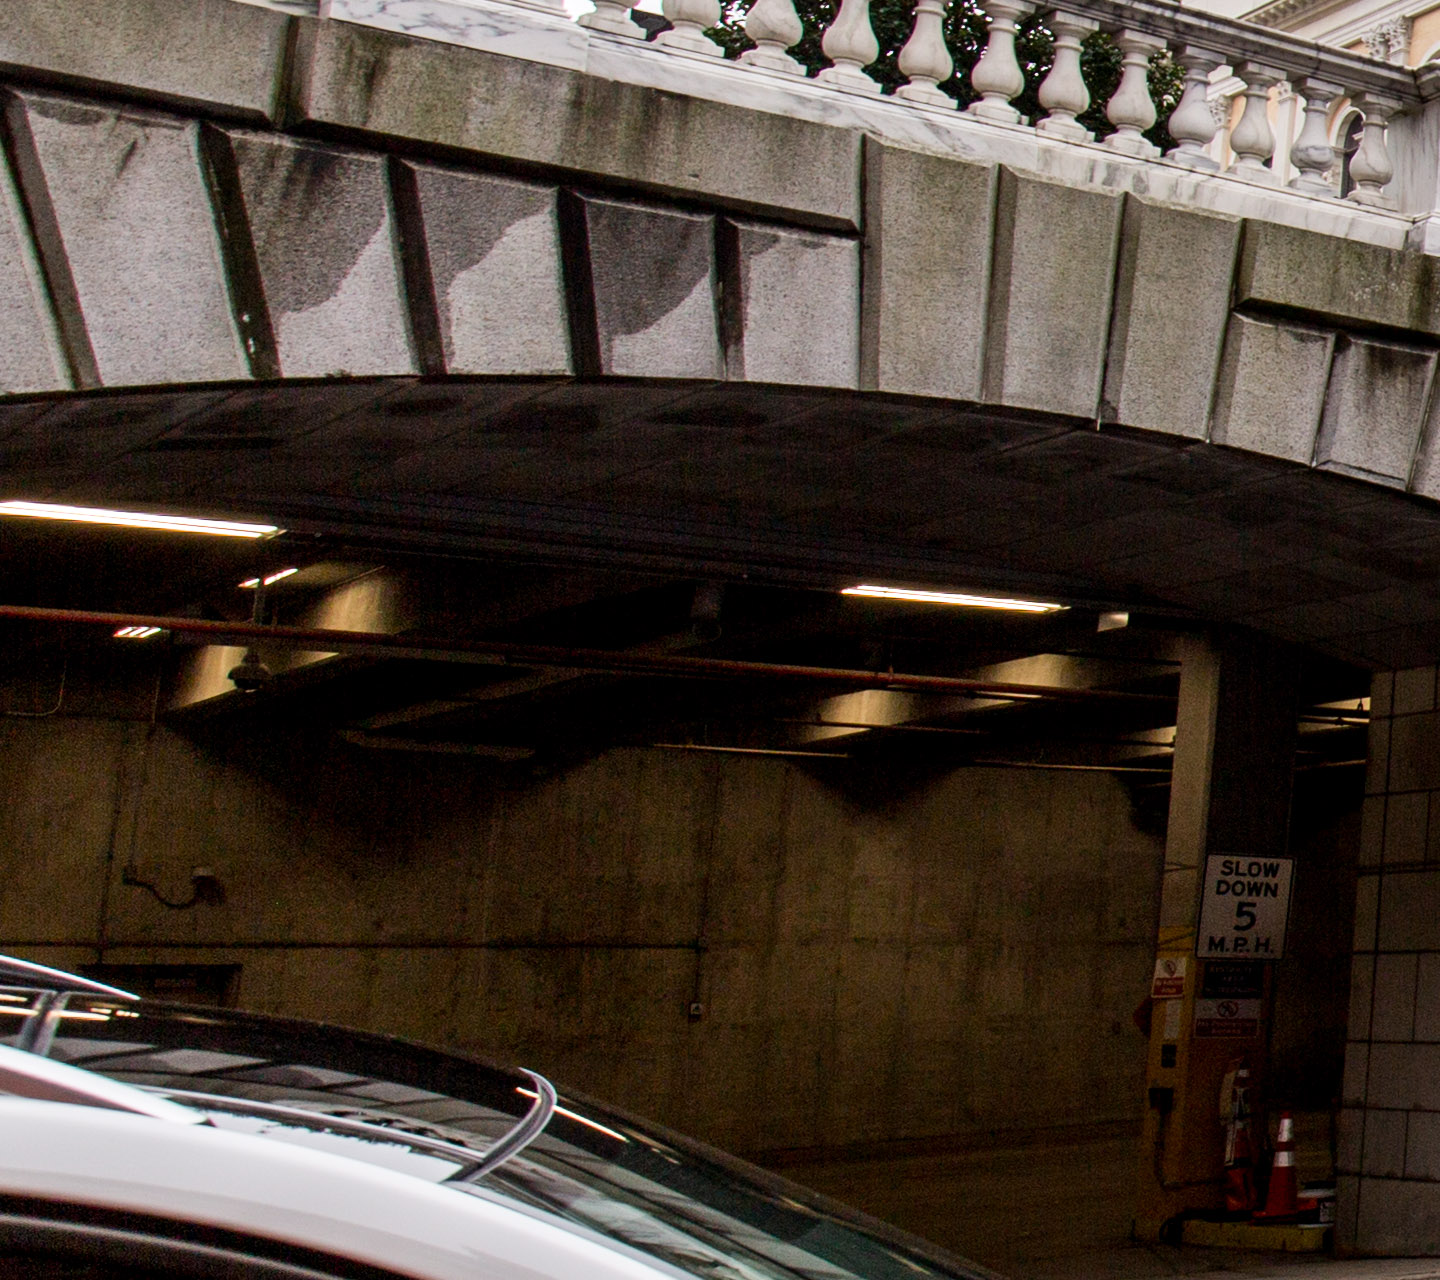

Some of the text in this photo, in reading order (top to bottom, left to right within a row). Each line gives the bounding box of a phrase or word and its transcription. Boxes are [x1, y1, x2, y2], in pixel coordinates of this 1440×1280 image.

[1220, 859, 1280, 879] SLOW
[1215, 880, 1278, 897] DOWN
[1233, 901, 1257, 931] 5
[1208, 936, 1274, 953] M.P.H.
